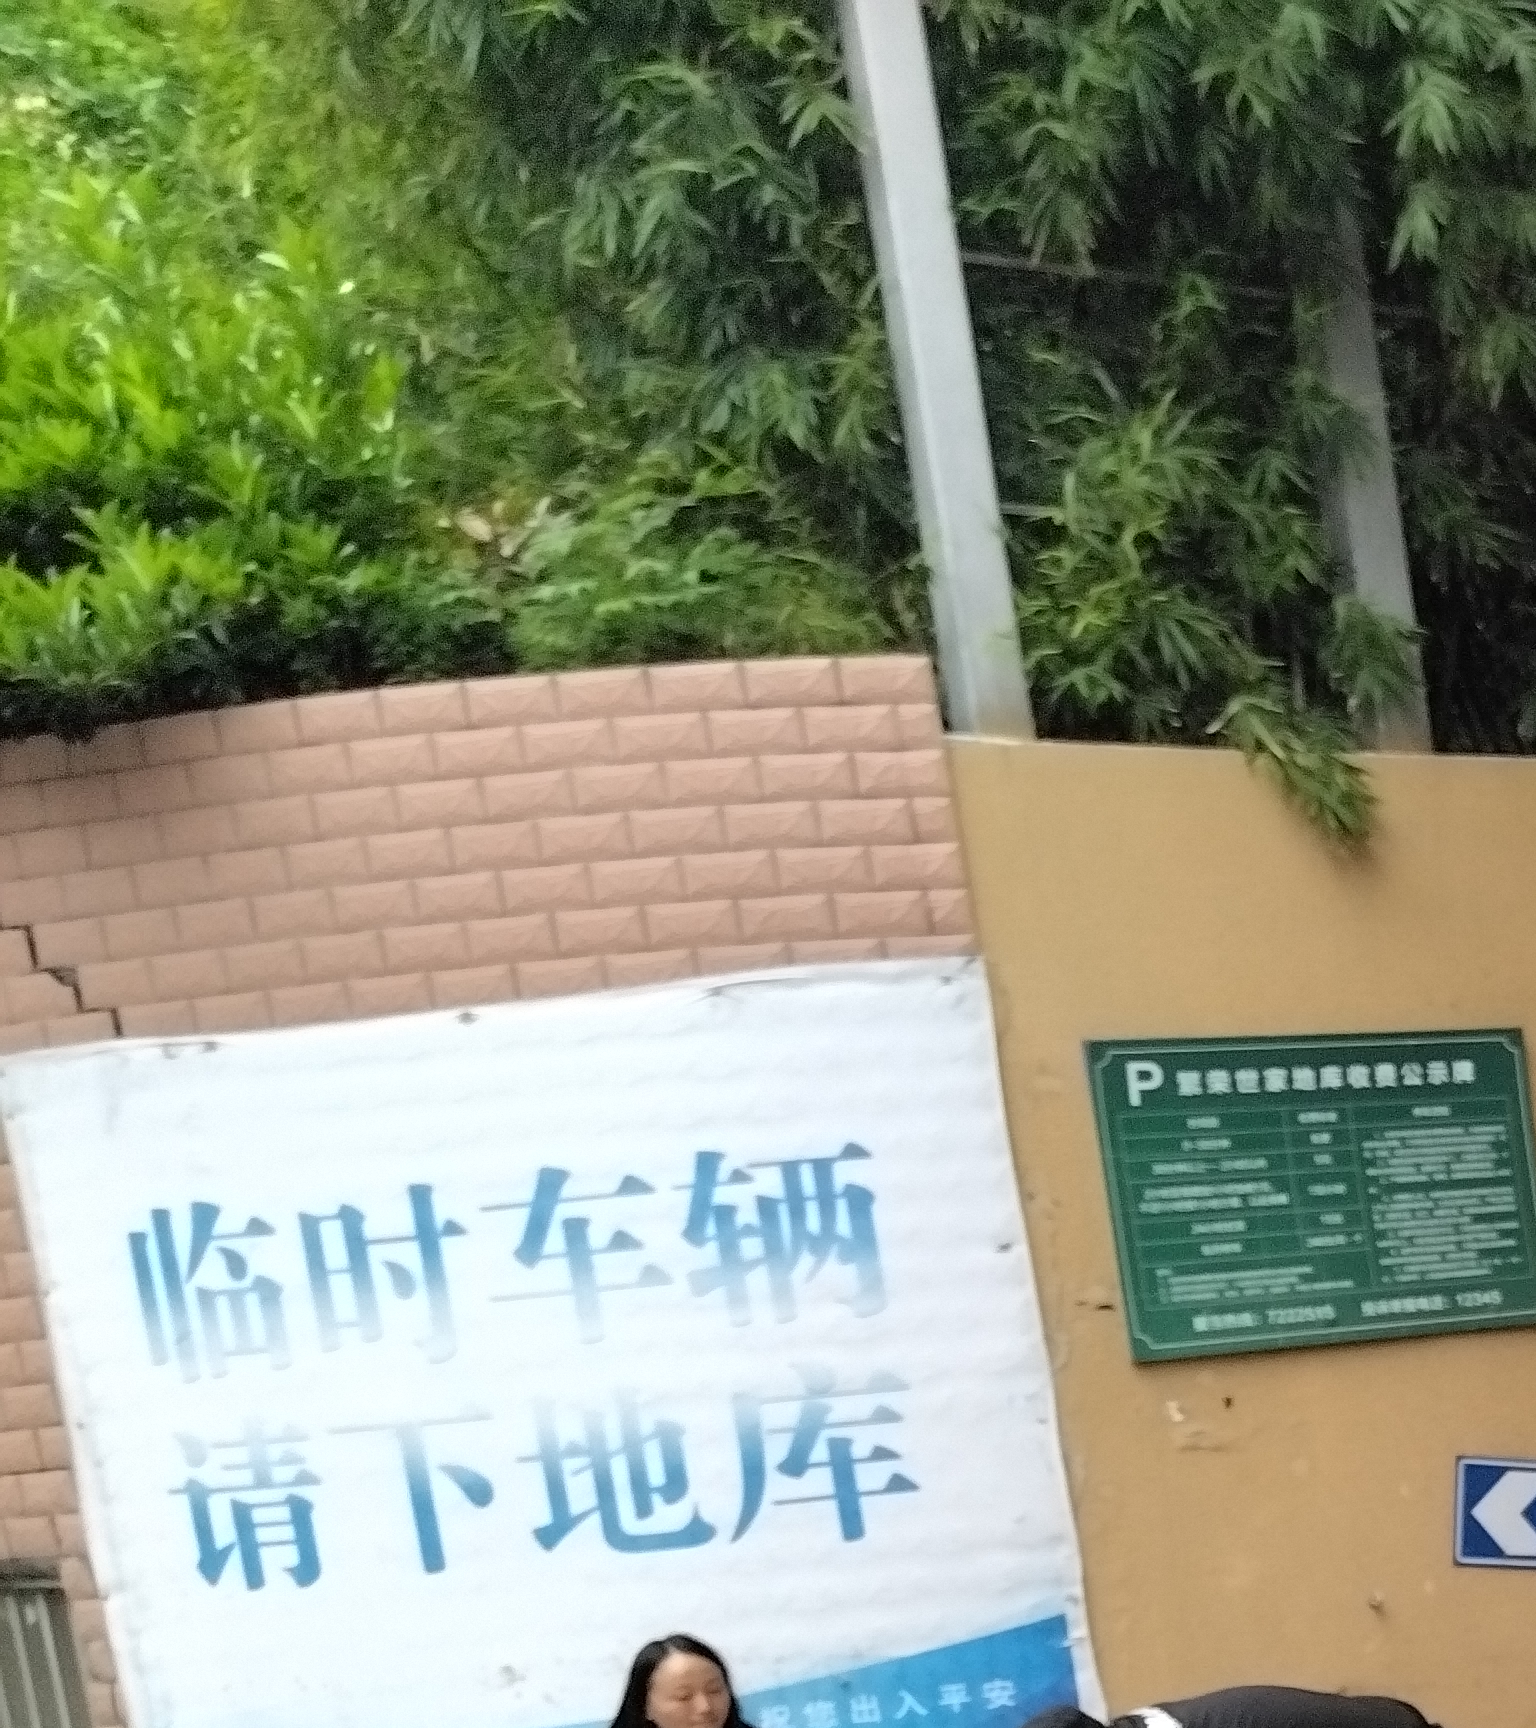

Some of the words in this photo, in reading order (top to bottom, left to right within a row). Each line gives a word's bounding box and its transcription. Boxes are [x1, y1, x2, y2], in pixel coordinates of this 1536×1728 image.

[1125, 1060, 1164, 1107] P
[129, 1142, 890, 1383] 临时车辆
[169, 1366, 920, 1591] 请下地库
